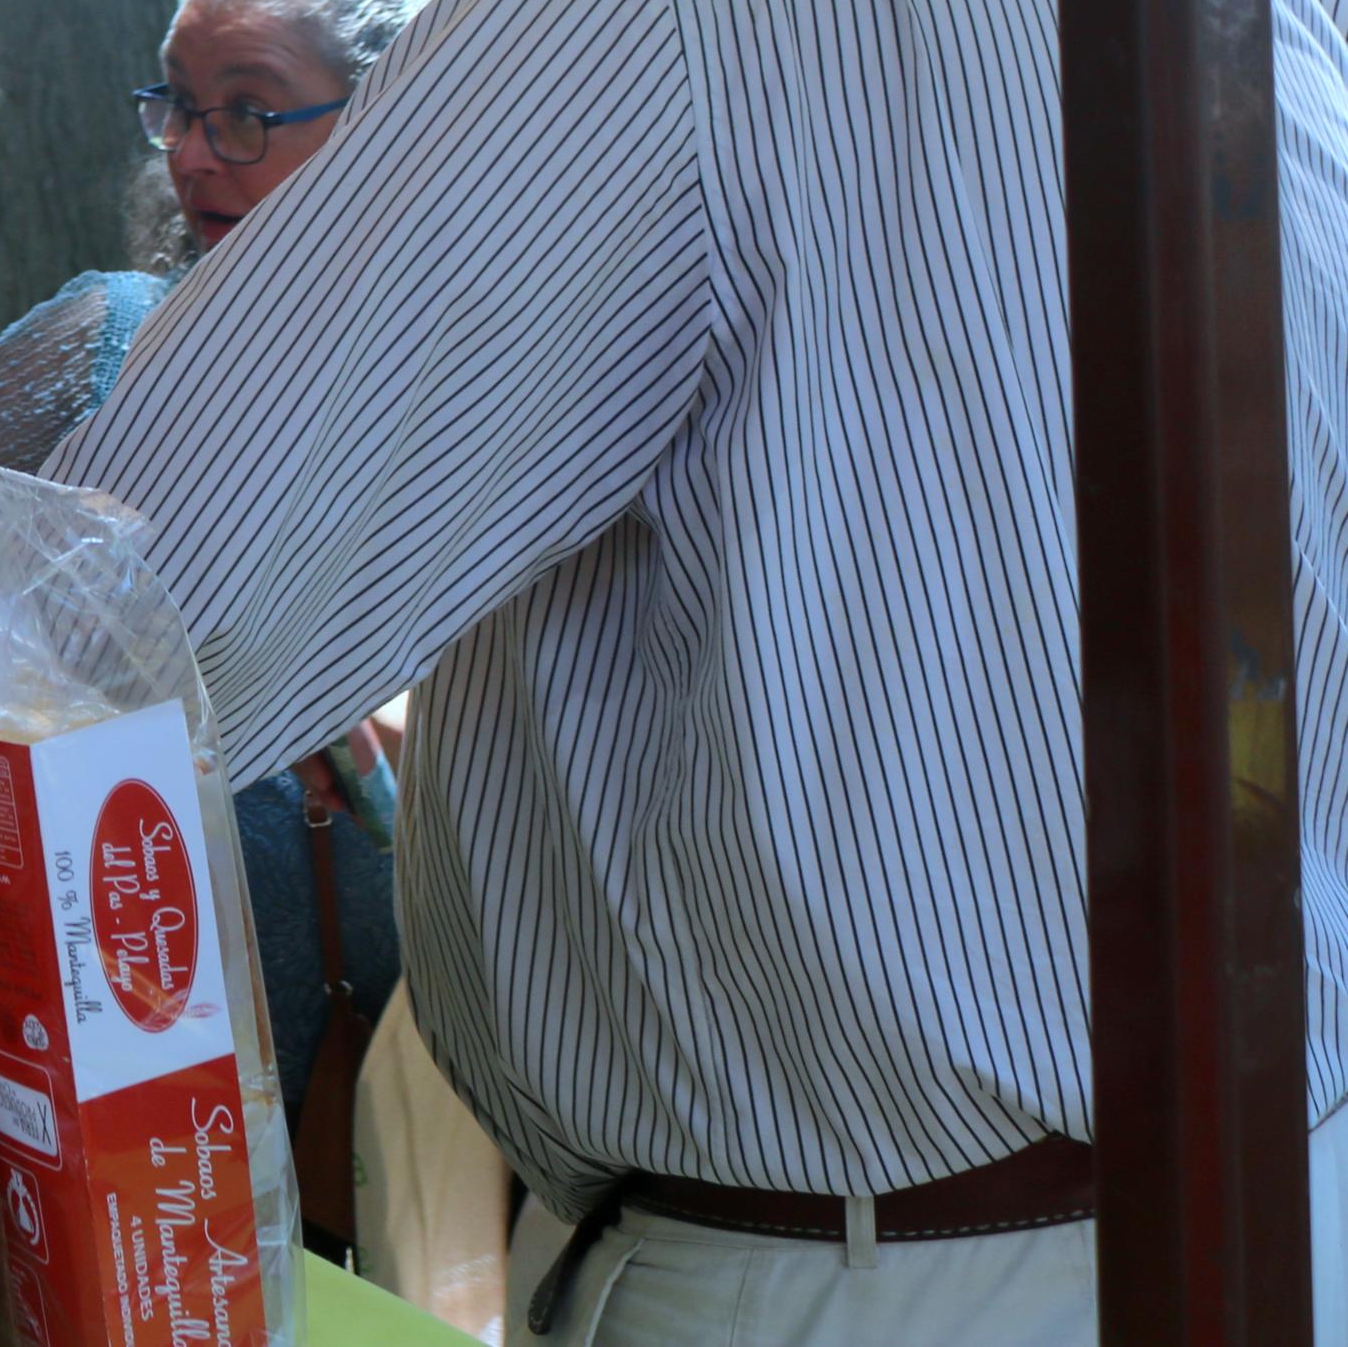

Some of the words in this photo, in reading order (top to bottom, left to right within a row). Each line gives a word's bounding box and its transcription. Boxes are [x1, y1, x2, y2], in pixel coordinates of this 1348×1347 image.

[54, 850, 75, 883] 100
[102, 842, 136, 869] del
[139, 818, 174, 882] Sobaos
[61, 889, 79, 912] %
[102, 874, 141, 911] Pas
[139, 888, 161, 901] y
[63, 916, 103, 1025] Mantequilla
[110, 931, 150, 992] Pelayo
[150, 906, 189, 990] Quesadas
[148, 1136, 188, 1168] de
[191, 1096, 235, 1200] Sobaos
[106, 1192, 128, 1294] EMPAQUETADO
[129, 1215, 143, 1228] 4
[130, 1229, 154, 1322] UNIDADES
